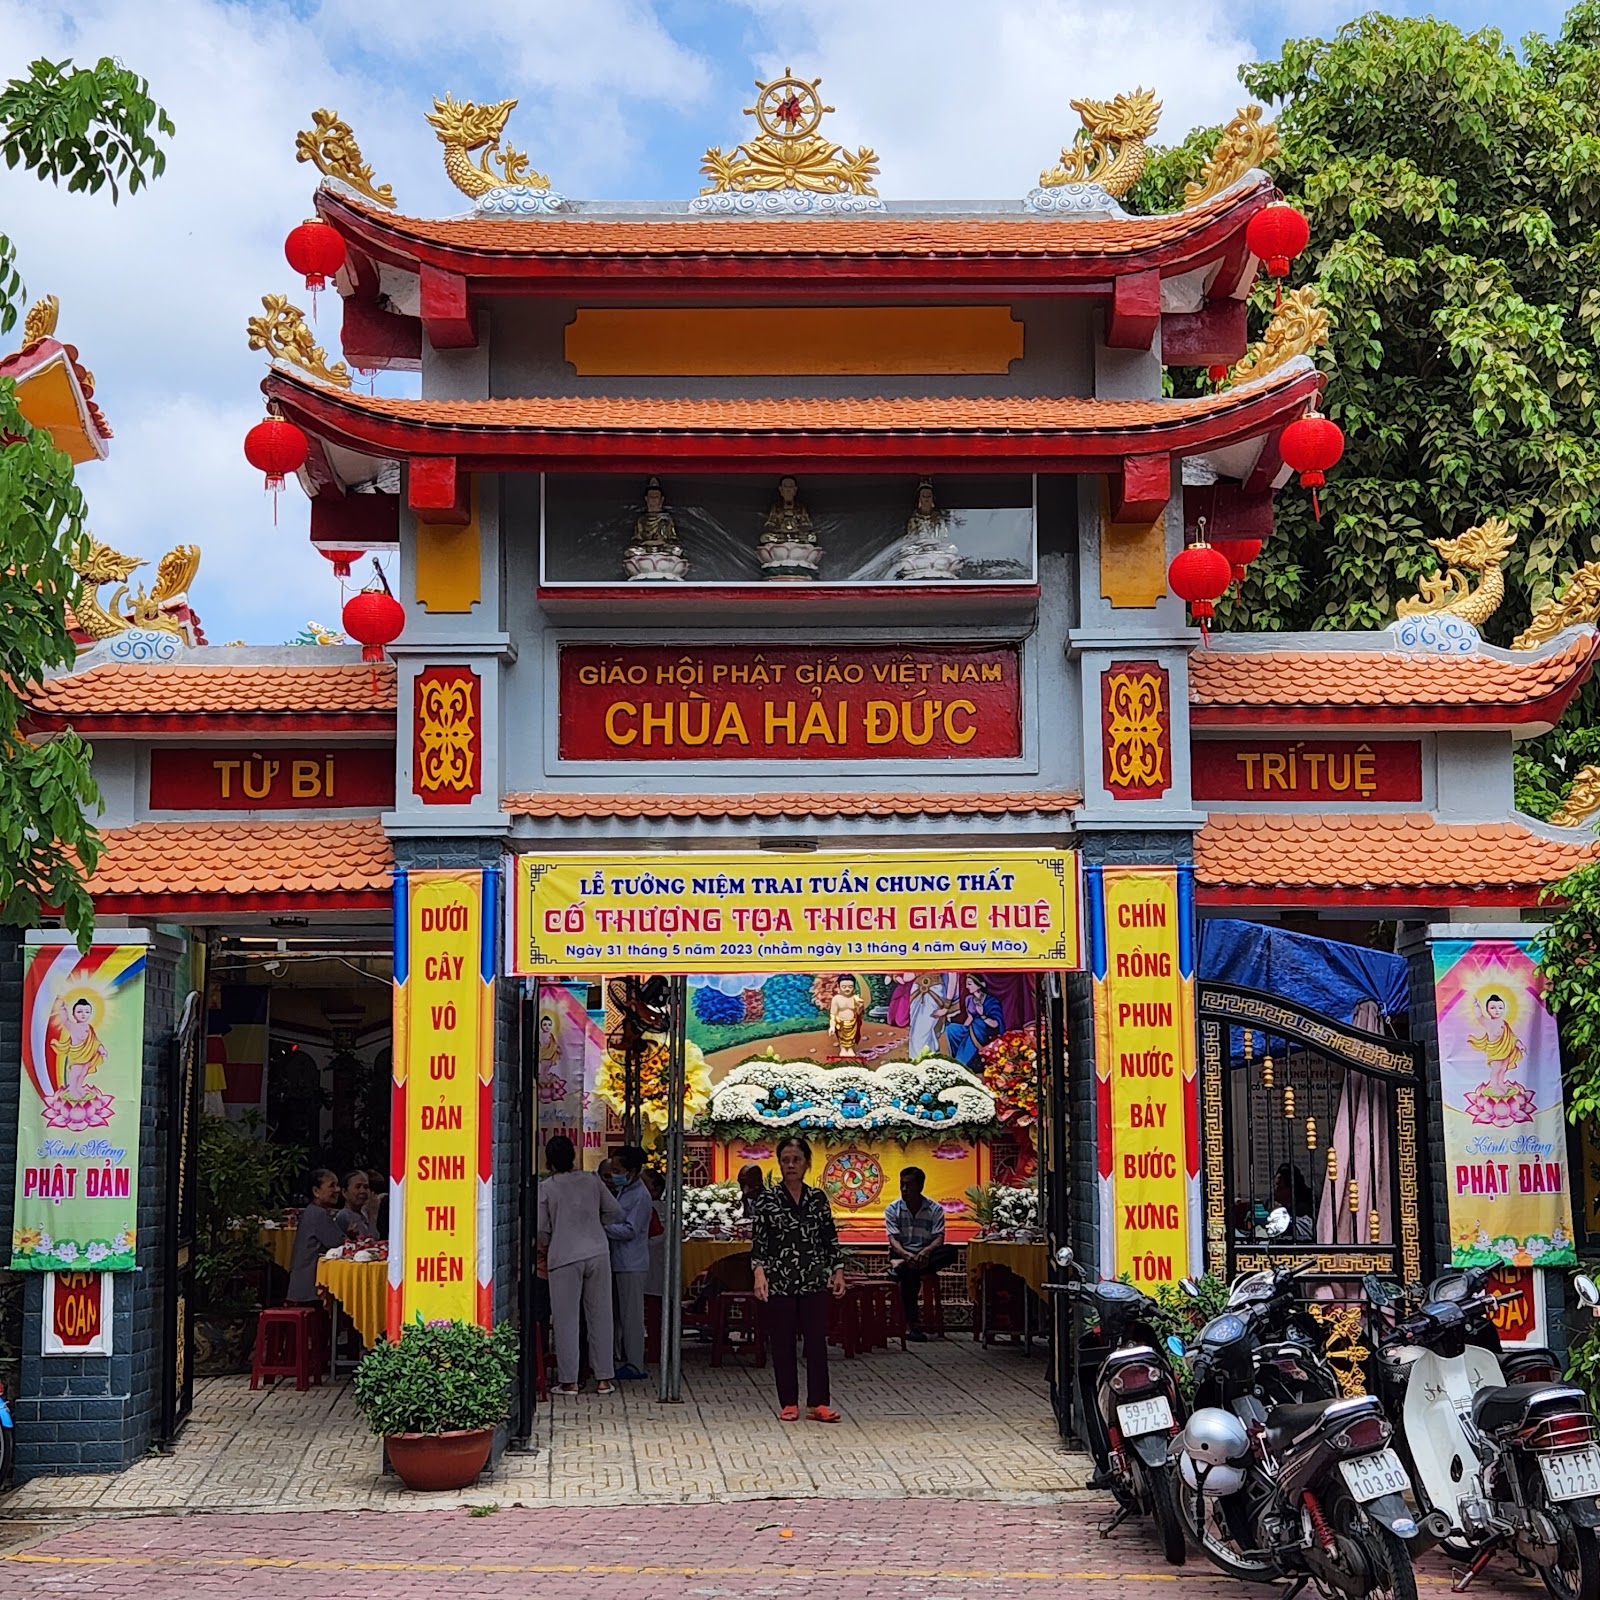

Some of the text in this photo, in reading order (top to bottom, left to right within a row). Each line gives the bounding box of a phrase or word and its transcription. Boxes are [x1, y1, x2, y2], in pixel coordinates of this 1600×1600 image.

[579, 653, 1003, 690] GIÁO HỘI PHẬT GIÁO VIỆT NAM
[605, 686, 977, 746] CHÙA HẢI ĐỨC
[213, 752, 334, 798] TỪ BI
[1237, 742, 1377, 797] TRÍ TUỆ
[580, 868, 1015, 898] LỄ TƯỞNG NIỆM TRAI TUẦN CHUNG THẤT
[544, 899, 1051, 937] CỐ THƯỢNG TỌA THÍCH GIÁC HUỆ
[566, 940, 1028, 958] Ngày 31 tháng 5 năm 2023 (nhằm ngày 13 tháng 4 năm Quý Mão)
[416, 900, 469, 1287] DƯỚI CÂY VÔ ƯU ĐẢN SINH THỊ HIỆN
[1116, 898, 1179, 1281] CHÍN RỒNG PHUN NƯỚC BẢY BƯỚC XƯNG TÔN
[37, 1139, 126, 1163] Kính Mừng
[1466, 1135, 1553, 1157] Kính Mừng
[24, 1159, 130, 1204] PHẬT ĐẢN
[1456, 1154, 1561, 1200] PHẬT ĐẢN
[1124, 1413, 1169, 1435] 177.43
[1125, 1400, 1160, 1419] 59-B1
[1349, 1453, 1391, 1478] 75-B1
[1549, 1453, 1591, 1476] 51-F1
[1354, 1470, 1405, 1498] 103.80
